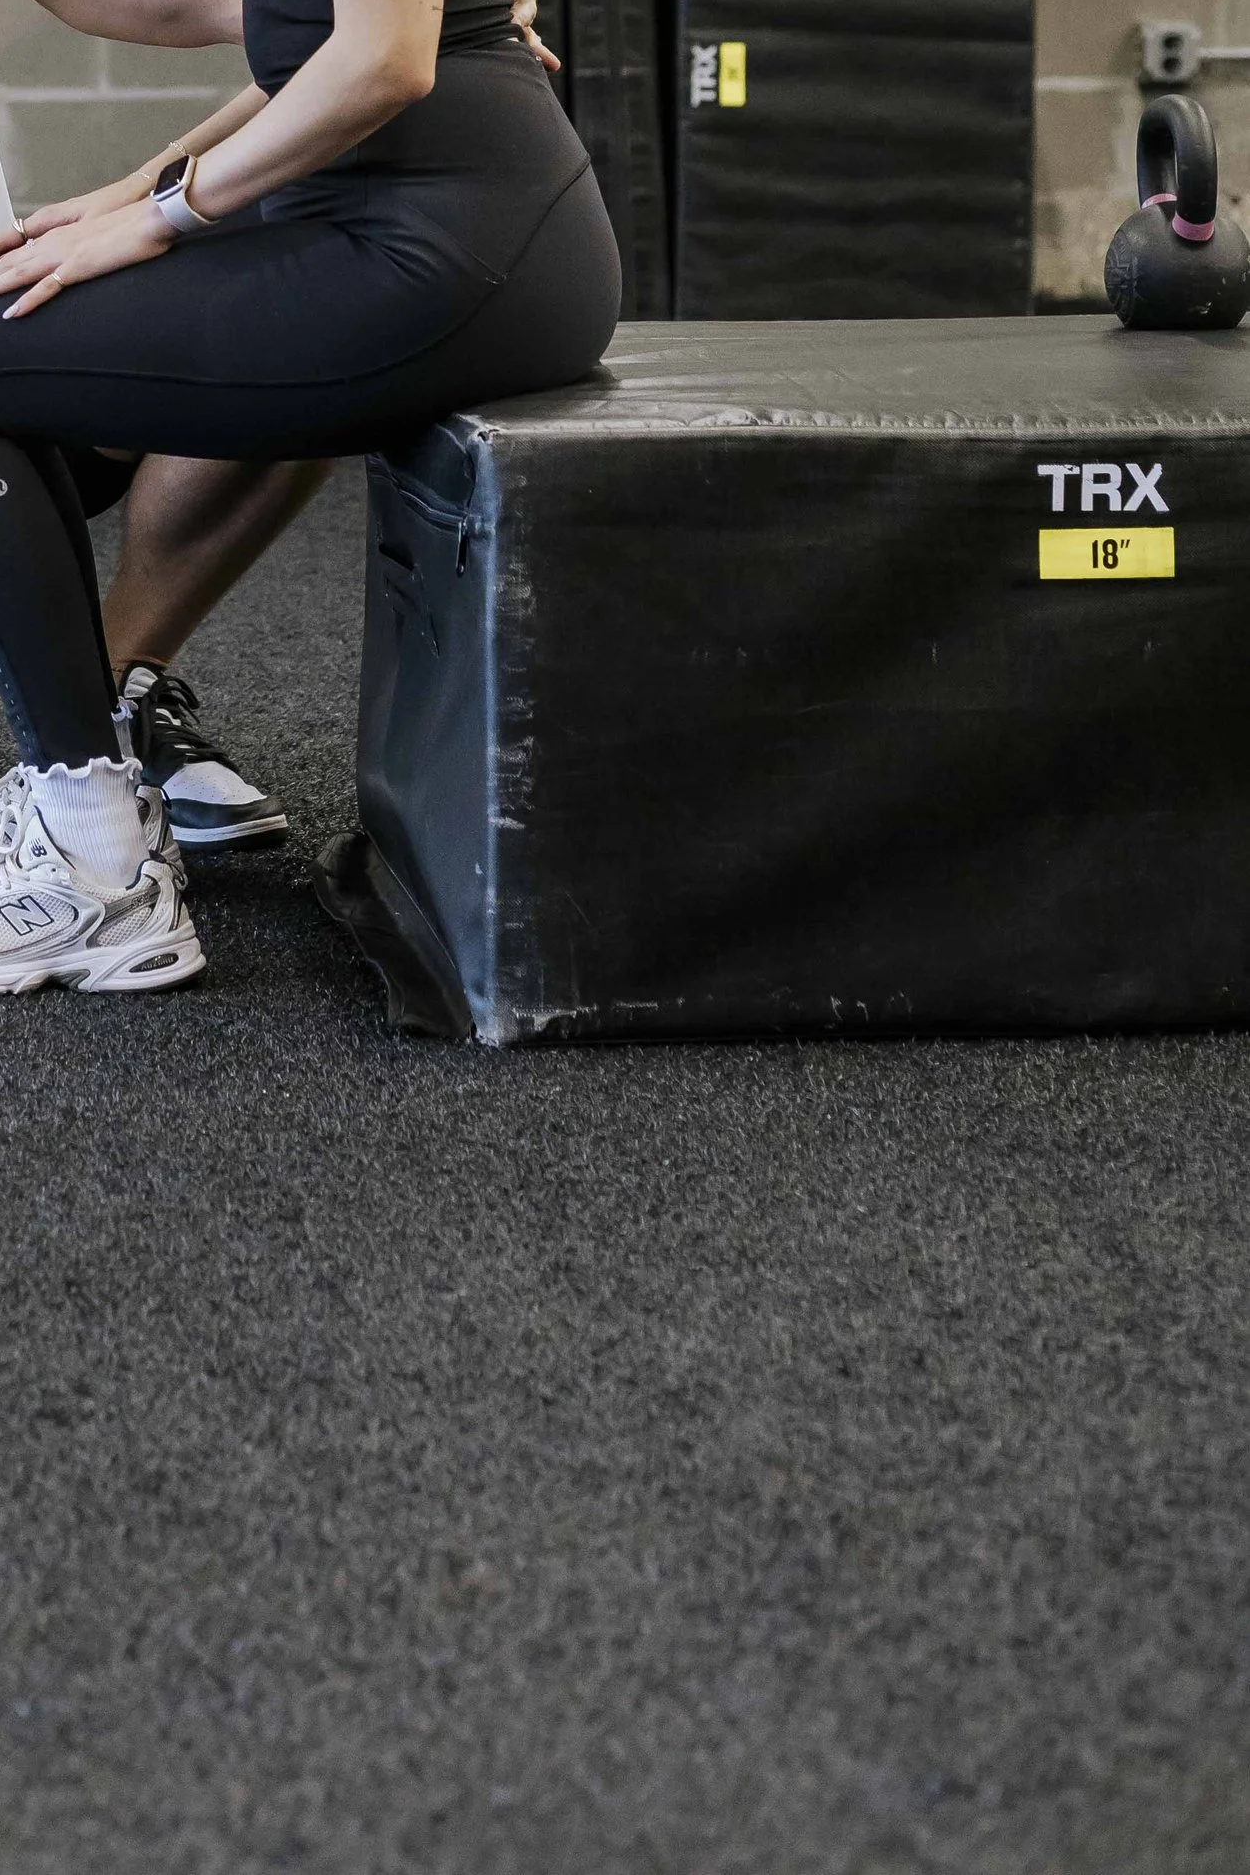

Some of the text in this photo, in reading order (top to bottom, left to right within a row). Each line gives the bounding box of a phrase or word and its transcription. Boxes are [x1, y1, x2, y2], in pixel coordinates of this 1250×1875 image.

[690, 44, 718, 109] TRX
[1037, 462, 1170, 513] TRX
[1091, 538, 1131, 570] 18"
